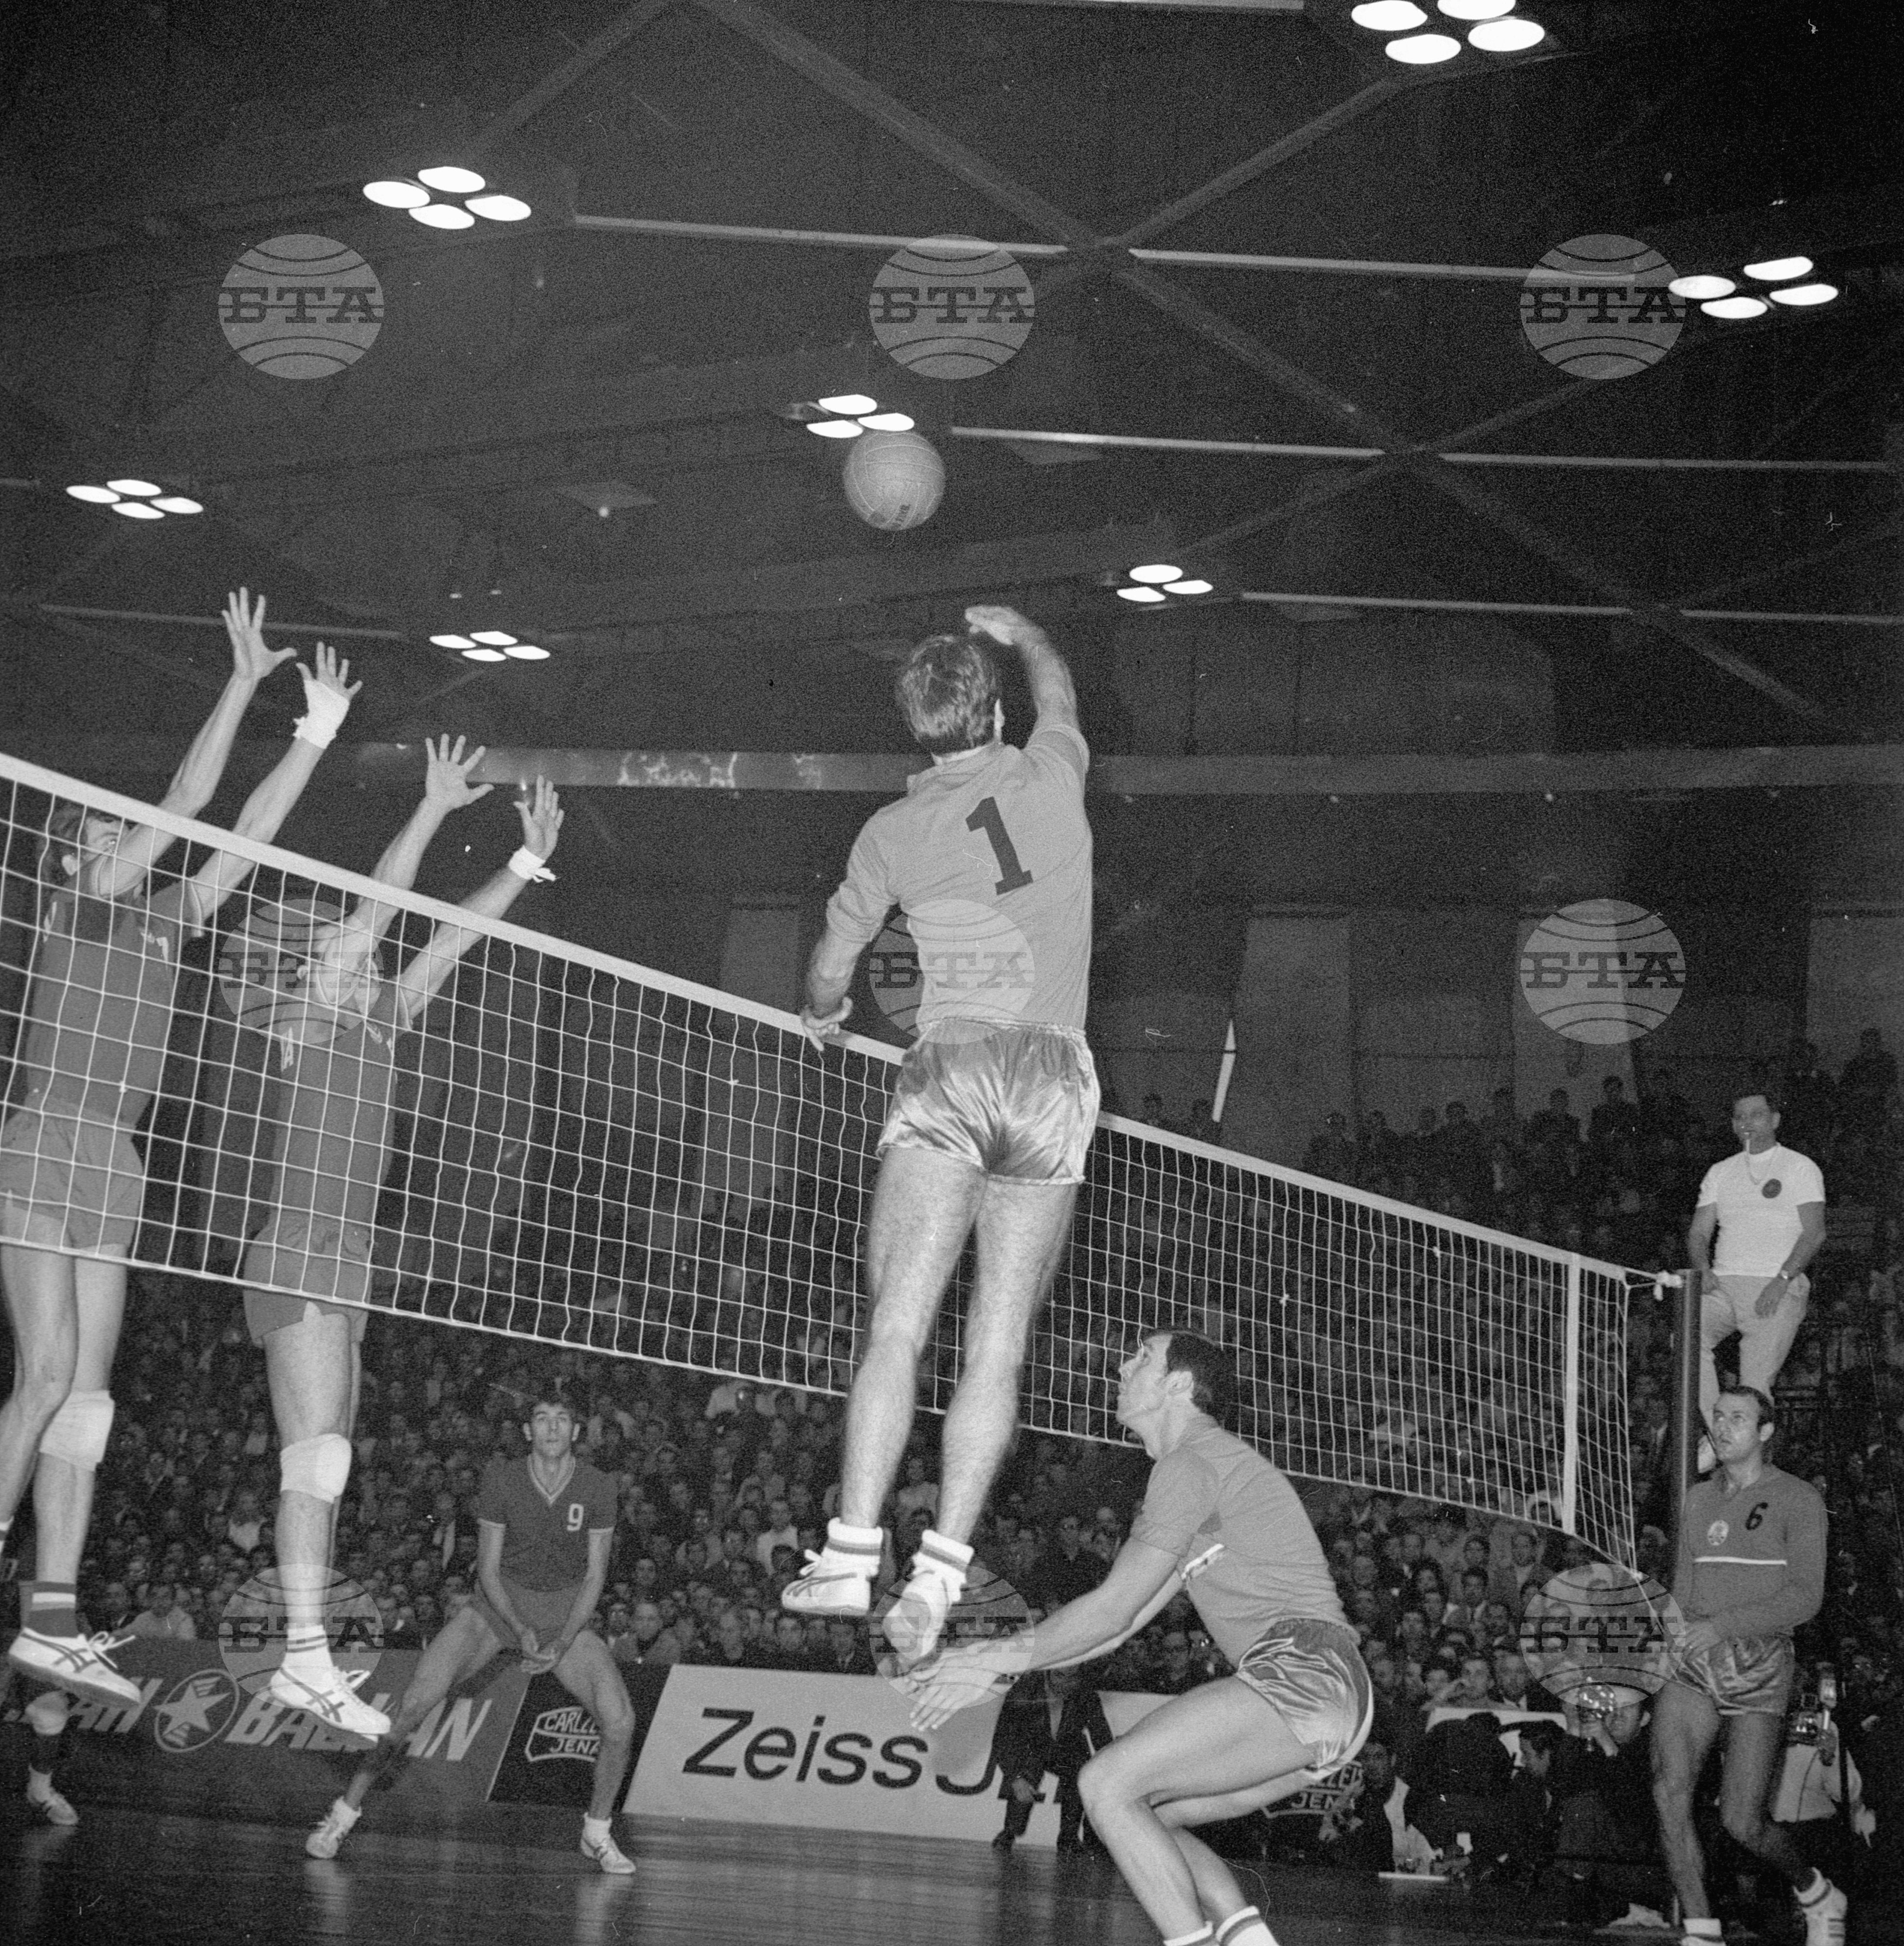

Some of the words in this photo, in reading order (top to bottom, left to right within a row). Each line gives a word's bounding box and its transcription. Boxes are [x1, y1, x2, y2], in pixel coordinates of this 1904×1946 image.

[966, 796, 1033, 895] 1
[567, 1503, 584, 1531] 9
[1745, 1502, 1768, 1530] 6
[682, 1707, 929, 1789] Zeiss
